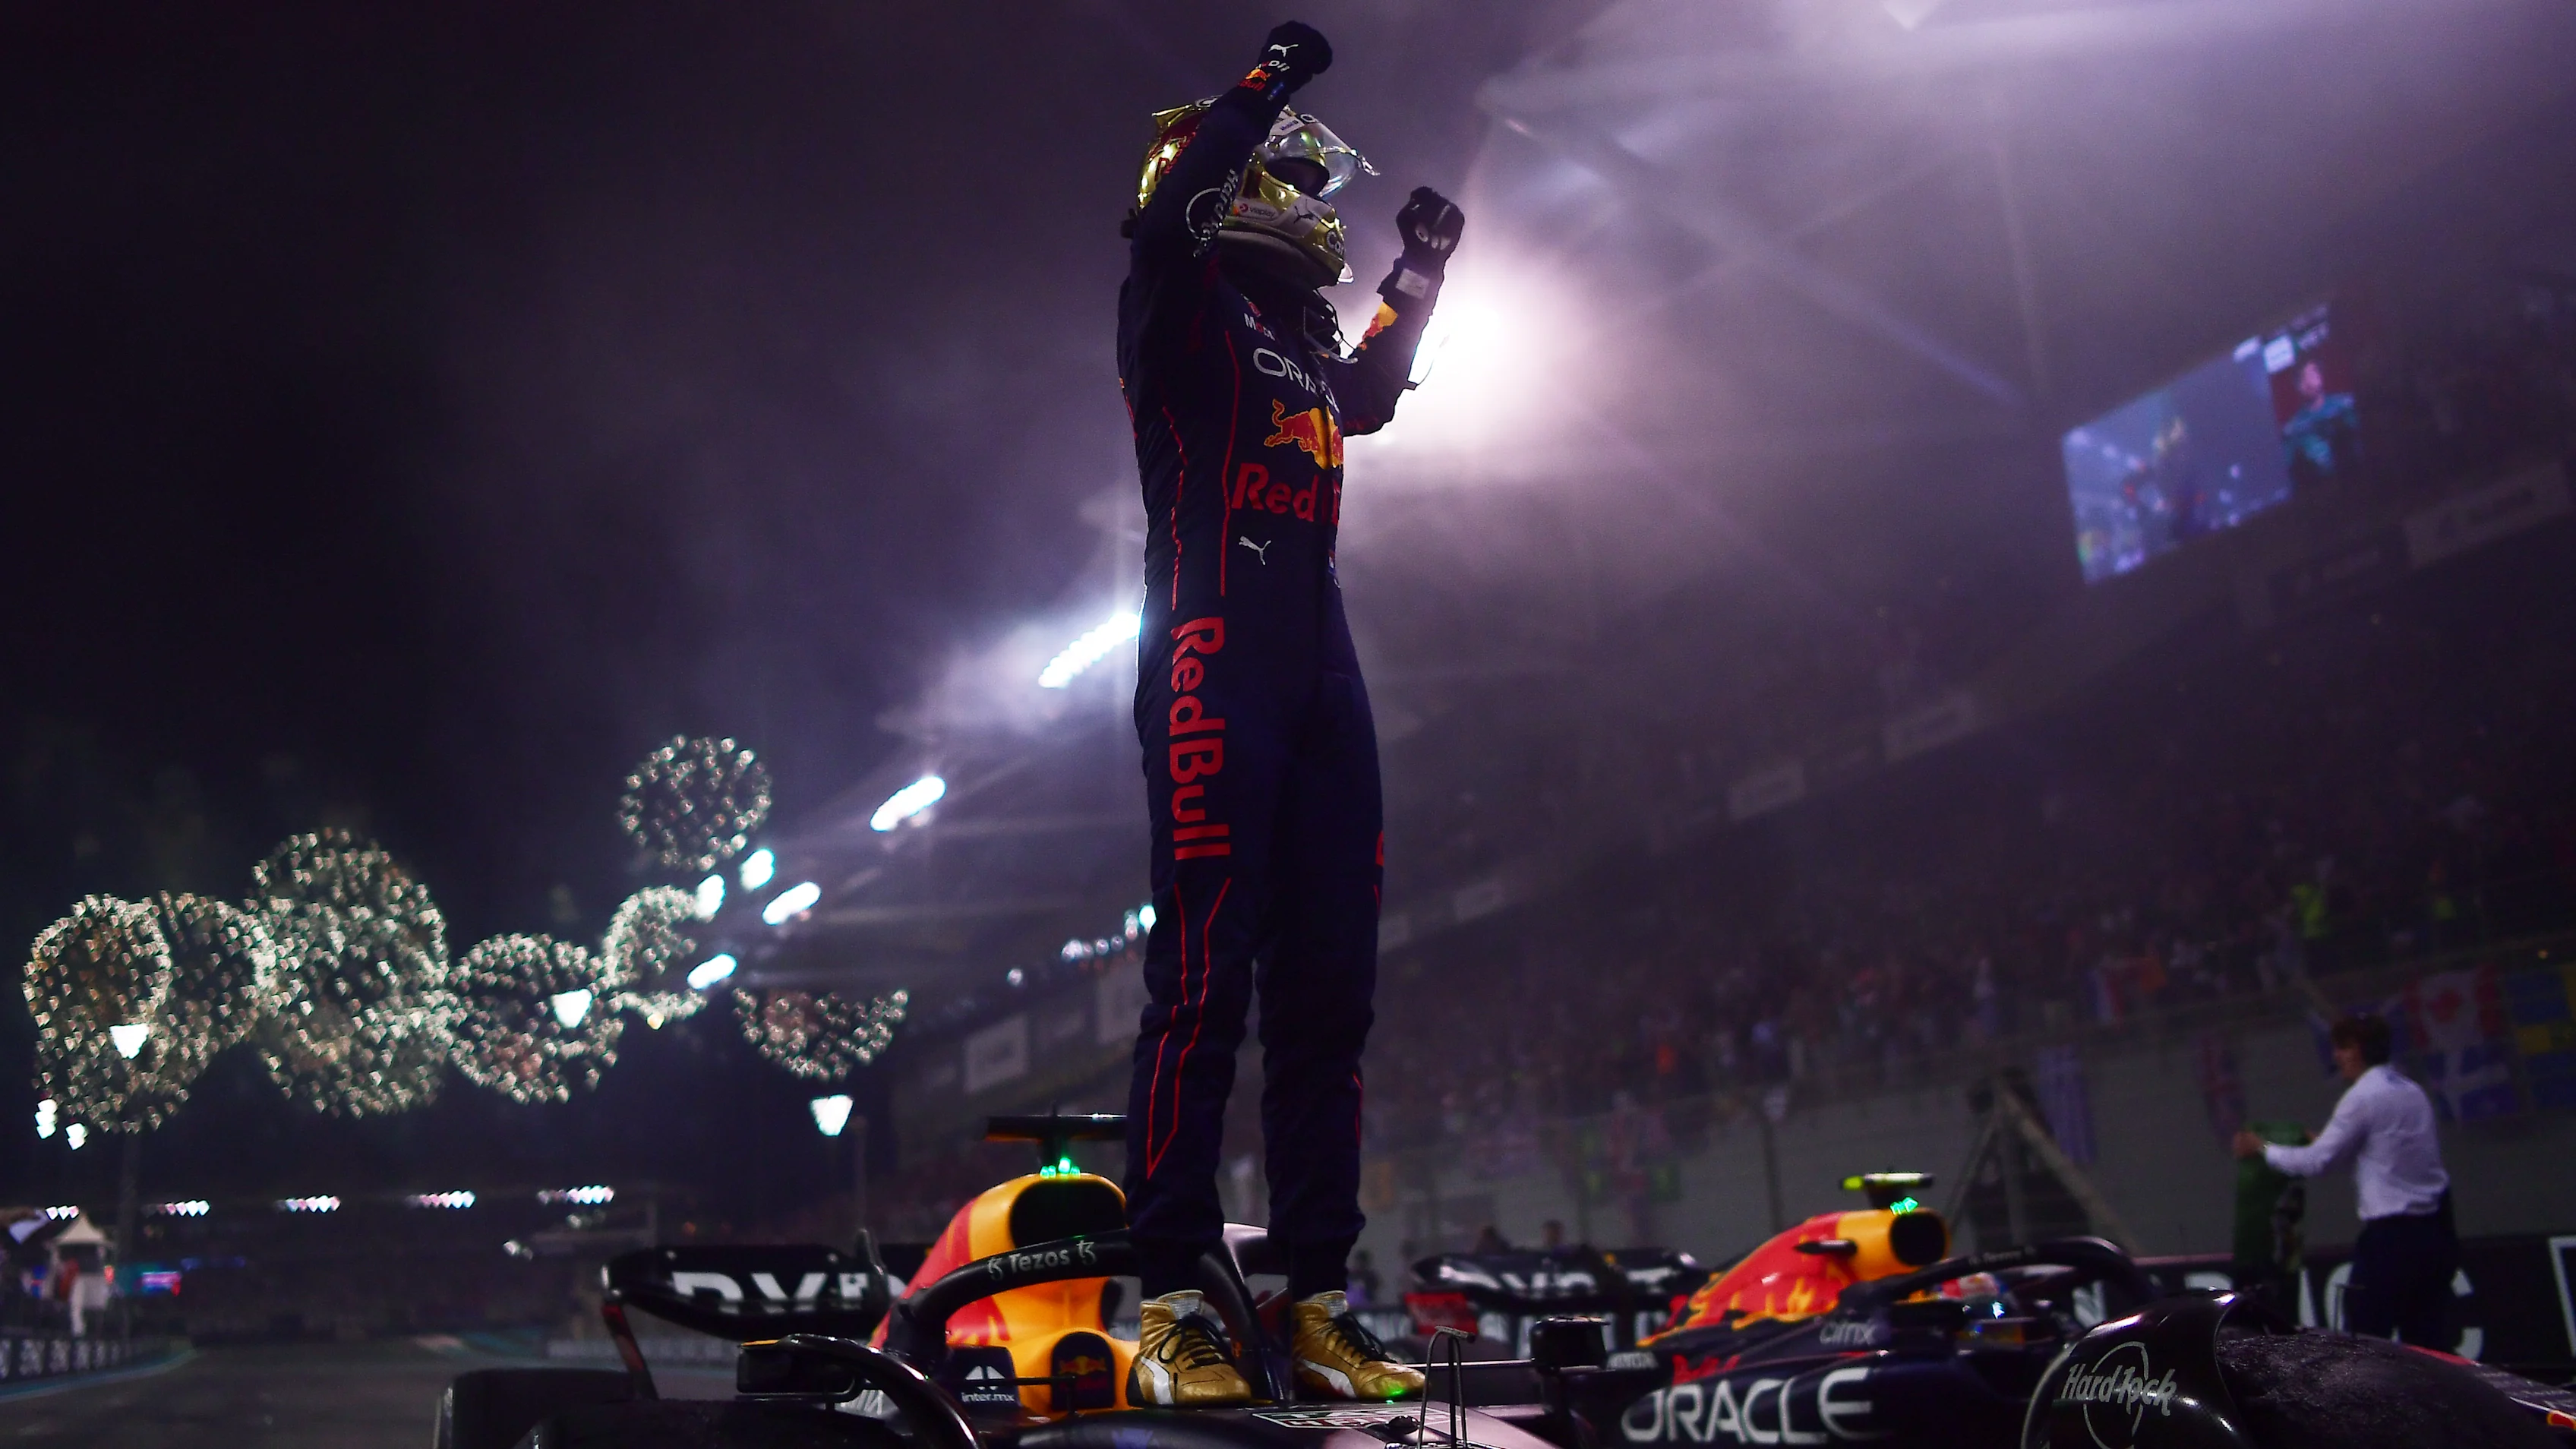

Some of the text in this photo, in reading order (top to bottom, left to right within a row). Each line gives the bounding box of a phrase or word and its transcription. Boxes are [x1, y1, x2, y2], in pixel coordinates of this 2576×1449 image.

[1009, 1249, 1071, 1274] Tezos
[961, 1391, 1015, 1403] inter.mx
[1620, 1366, 1876, 1444] ORACLE
